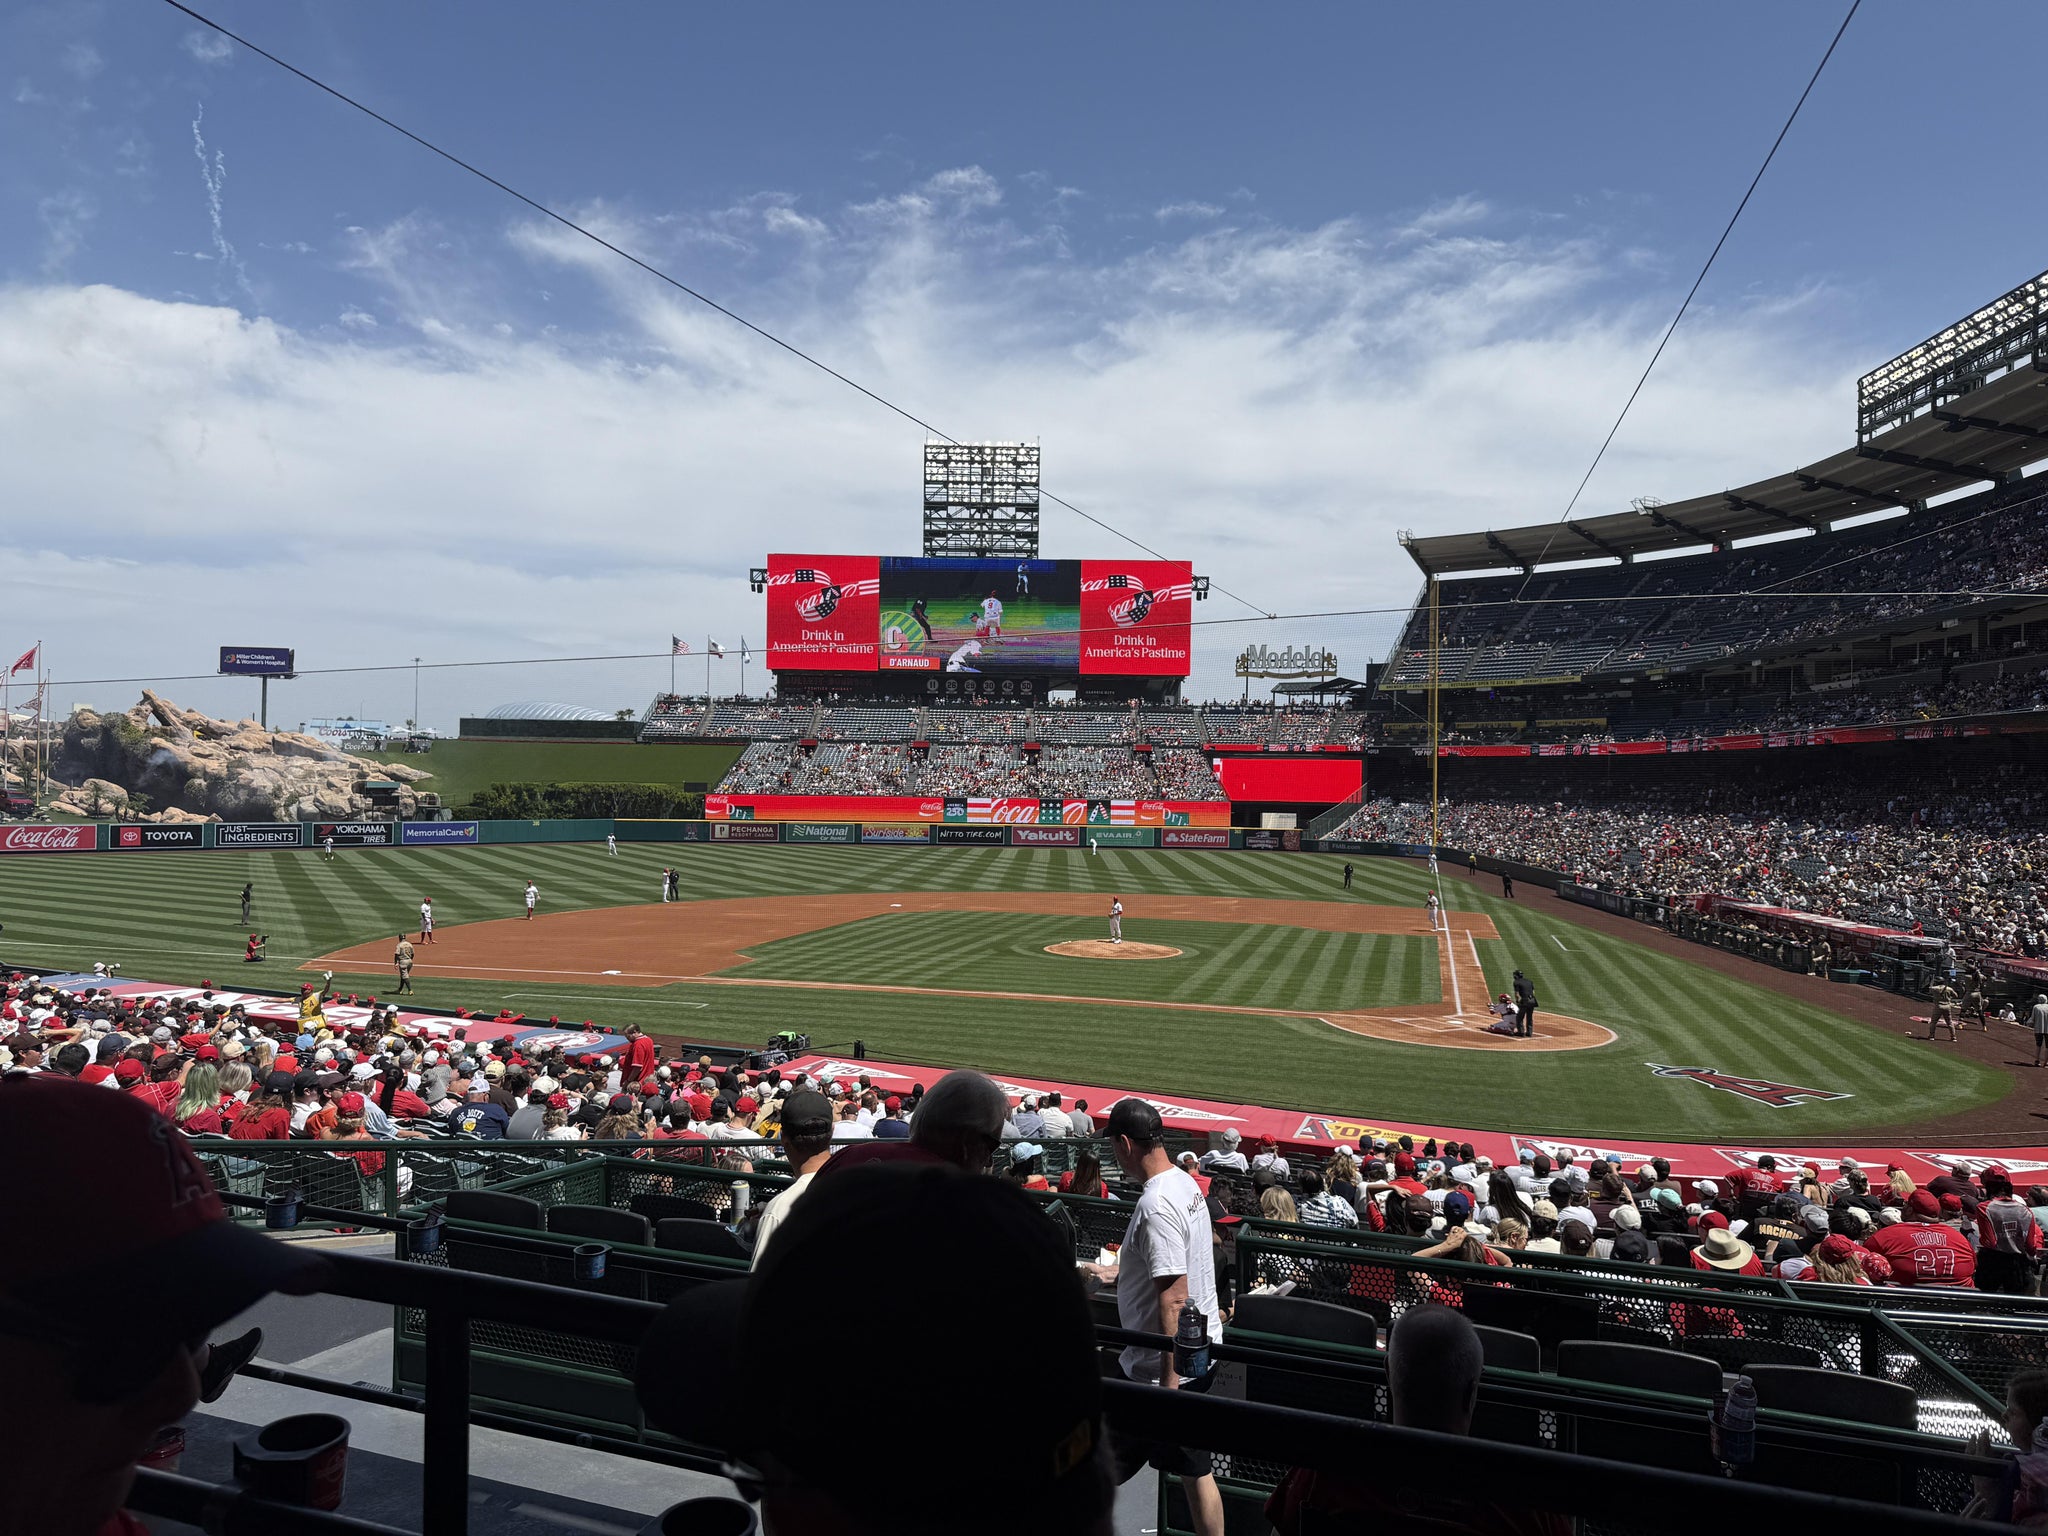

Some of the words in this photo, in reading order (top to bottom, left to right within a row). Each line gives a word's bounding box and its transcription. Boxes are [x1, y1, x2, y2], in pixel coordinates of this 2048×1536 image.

[802, 630, 831, 640] Drink
[834, 630, 844, 640] in
[1114, 635, 1144, 645] Drink
[1146, 635, 1156, 645] in
[772, 642, 828, 653] America's
[829, 643, 874, 653] Pastime
[1085, 647, 1140, 657] America's
[1141, 648, 1186, 658] Pastime
[1249, 644, 1323, 668] Modelo
[889, 658, 930, 668] D'ARNAUD
[335, 825, 386, 834] YOKOHAMA
[406, 829, 464, 838] MemorialCare
[805, 826, 849, 836] National
[865, 826, 904, 838] Surfside
[5, 826, 84, 848] Coca-Cola
[145, 831, 193, 841] TOYOTA
[225, 833, 294, 842] INGREDIENTS
[1016, 830, 1075, 841] Yakult
[1179, 833, 1226, 843] StateFarm
[1911, 1232, 1947, 1246] TROUT
[1913, 1249, 1955, 1278] 27
